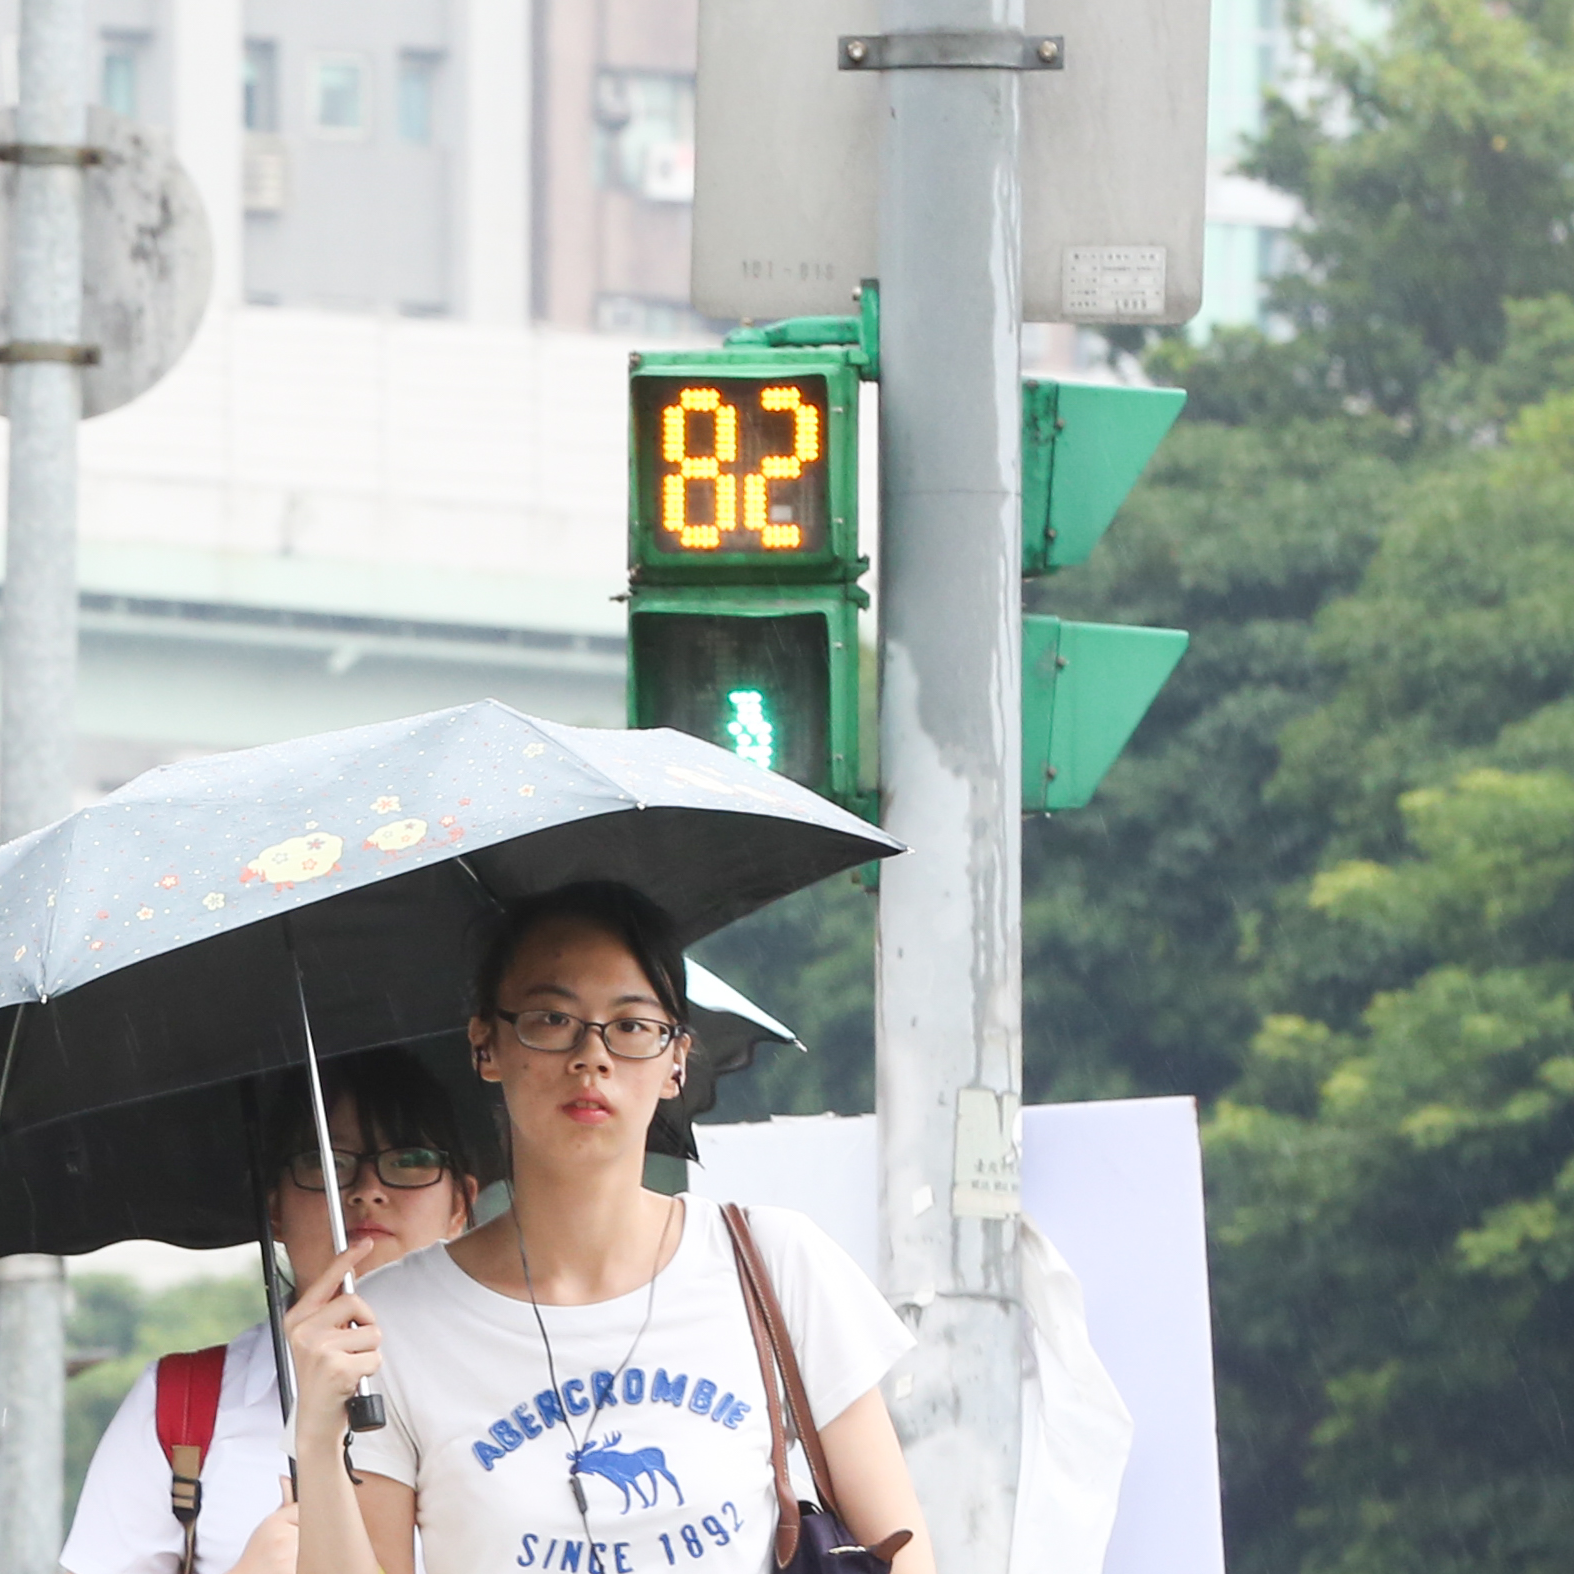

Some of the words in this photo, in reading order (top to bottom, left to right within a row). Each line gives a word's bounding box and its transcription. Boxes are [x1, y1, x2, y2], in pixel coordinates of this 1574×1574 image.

[662, 386, 820, 549] 82
[471, 1367, 751, 1472] ABERCROMBIE
[658, 1500, 745, 1566] 1892
